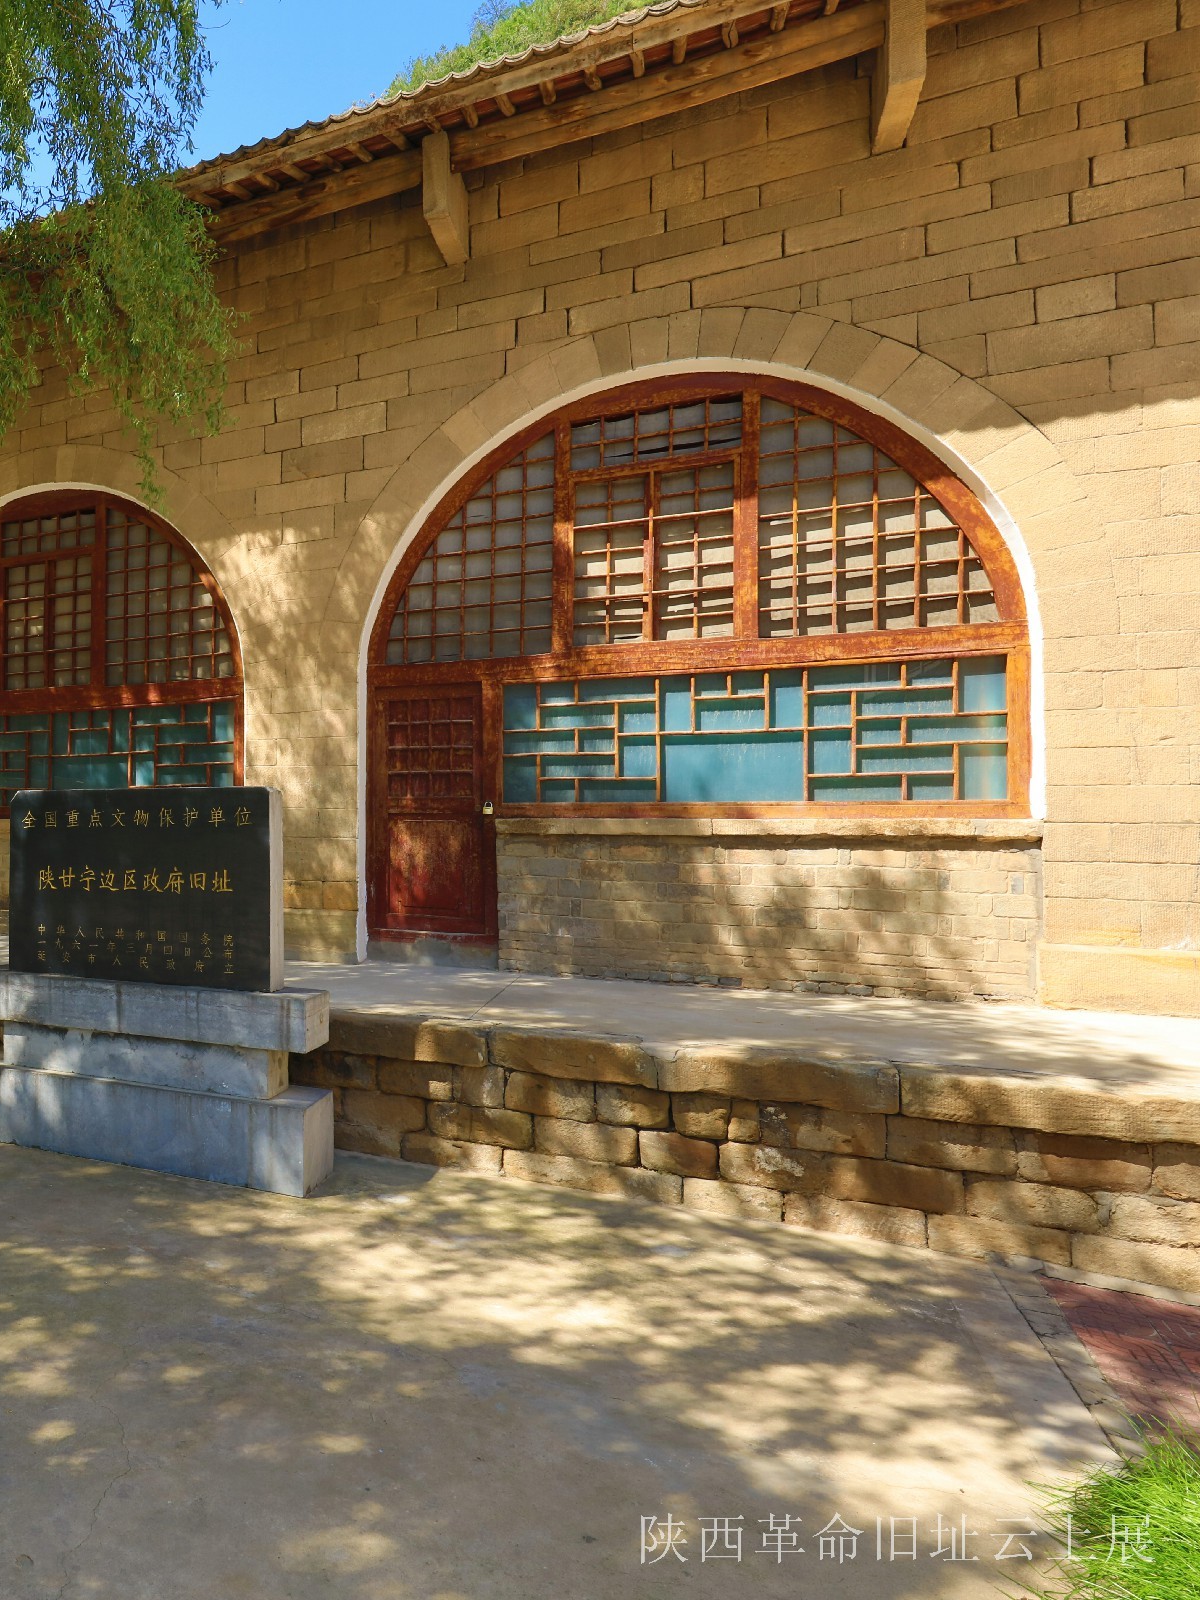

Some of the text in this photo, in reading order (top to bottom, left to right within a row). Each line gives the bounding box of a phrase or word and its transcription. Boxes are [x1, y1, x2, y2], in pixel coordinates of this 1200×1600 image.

[21, 805, 254, 829] 全国重点文物保护单位
[38, 865, 234, 894] 陕甘宁边区政府旧址
[37, 923, 234, 948] 中华人民共和国国务院
[37, 938, 234, 961] 一九六一年三月四日公布
[37, 950, 234, 974] 延安市人民政府立
